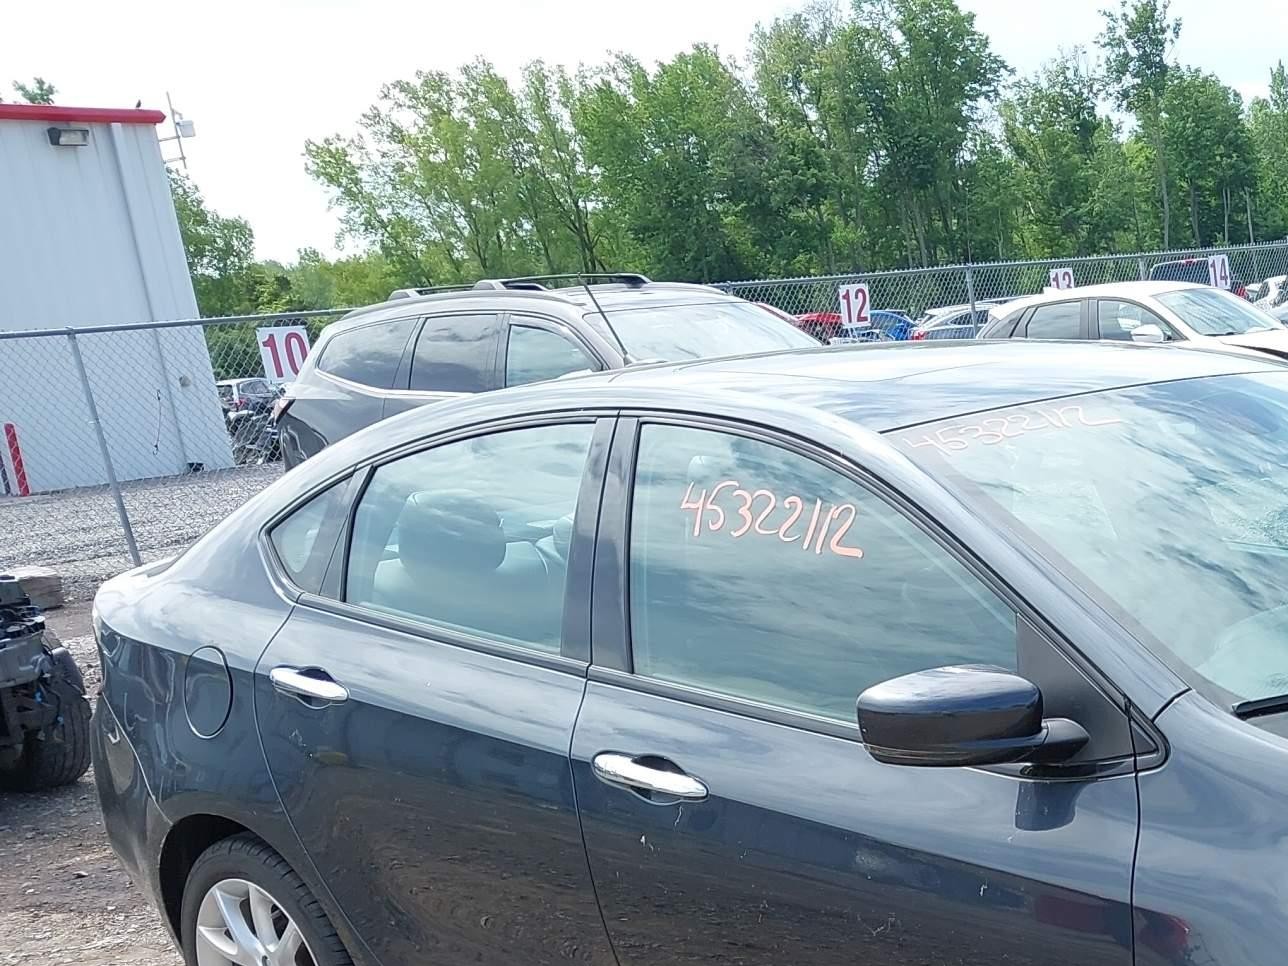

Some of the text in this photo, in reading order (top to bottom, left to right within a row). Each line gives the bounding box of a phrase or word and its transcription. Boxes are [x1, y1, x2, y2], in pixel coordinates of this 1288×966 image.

[1210, 258, 1228, 287] 14
[842, 288, 868, 323] 12
[262, 332, 308, 378] 10
[902, 405, 1122, 456] 45322112
[680, 480, 864, 559] 45322112
